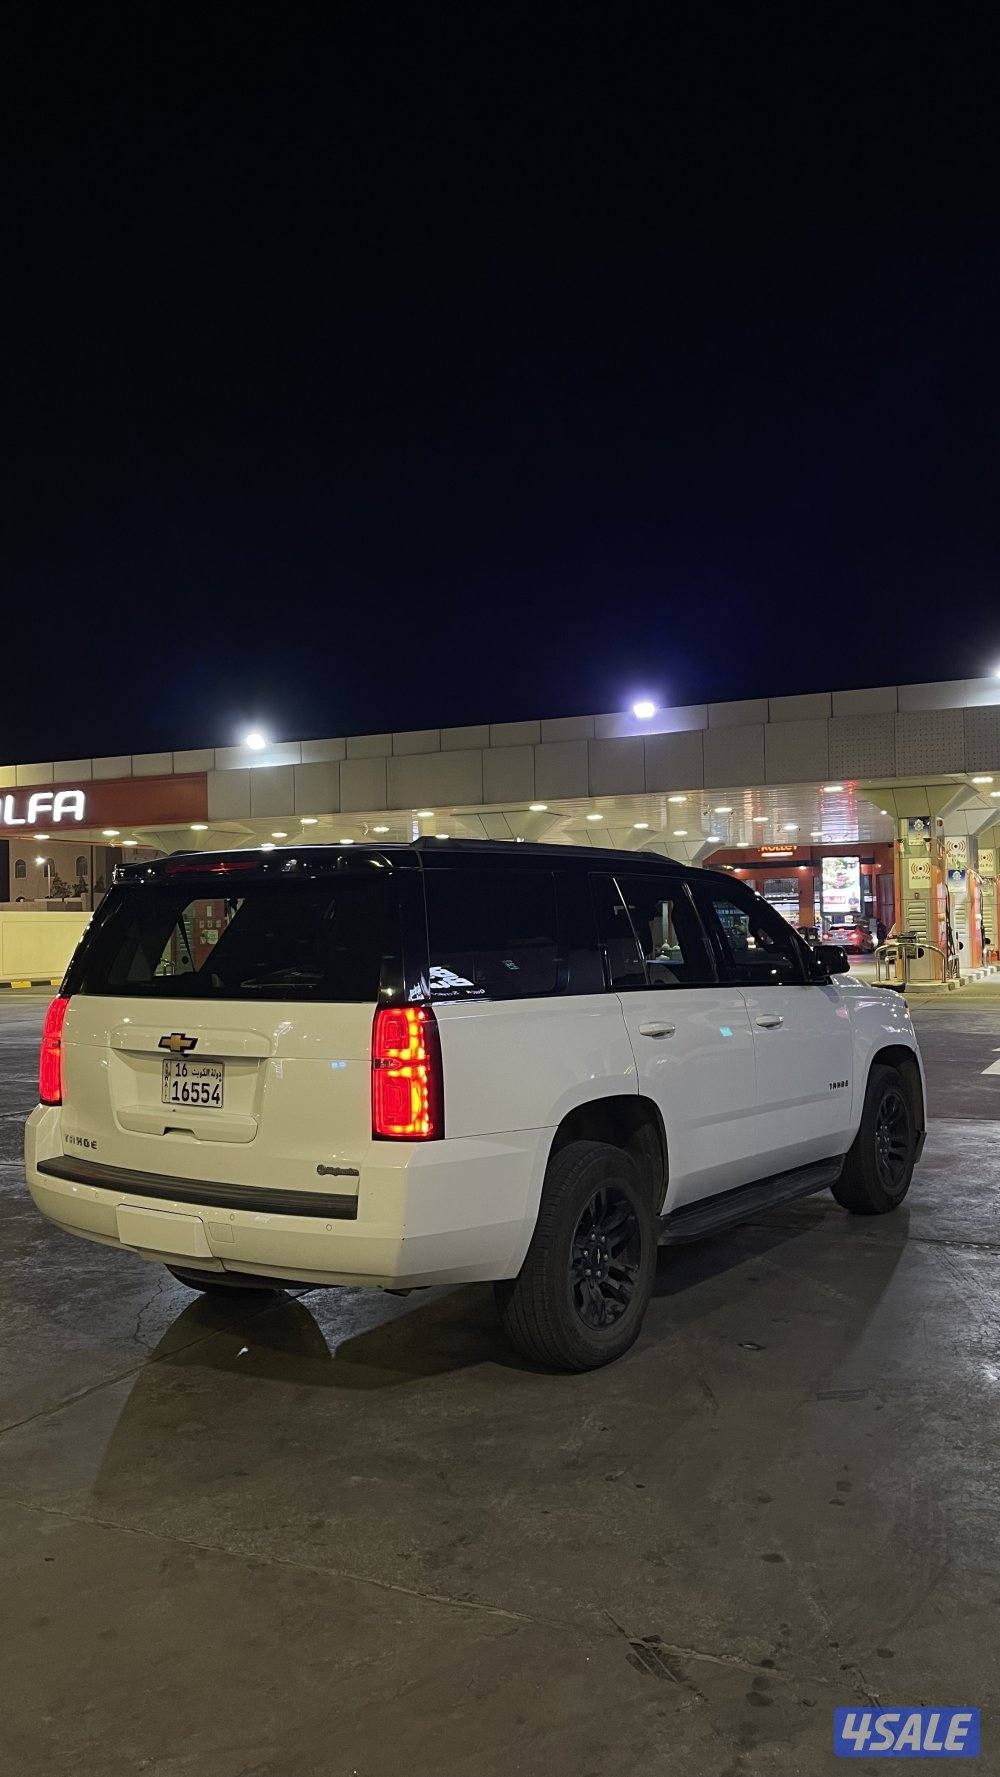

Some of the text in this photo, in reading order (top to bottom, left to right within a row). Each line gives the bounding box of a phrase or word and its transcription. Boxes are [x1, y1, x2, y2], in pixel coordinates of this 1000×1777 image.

[0, 790, 86, 825] LFA
[175, 1062, 188, 1077] 16
[191, 1067, 222, 1079] دولة الكويت
[172, 1081, 220, 1104] 16554
[64, 1134, 98, 1150] TAHOE
